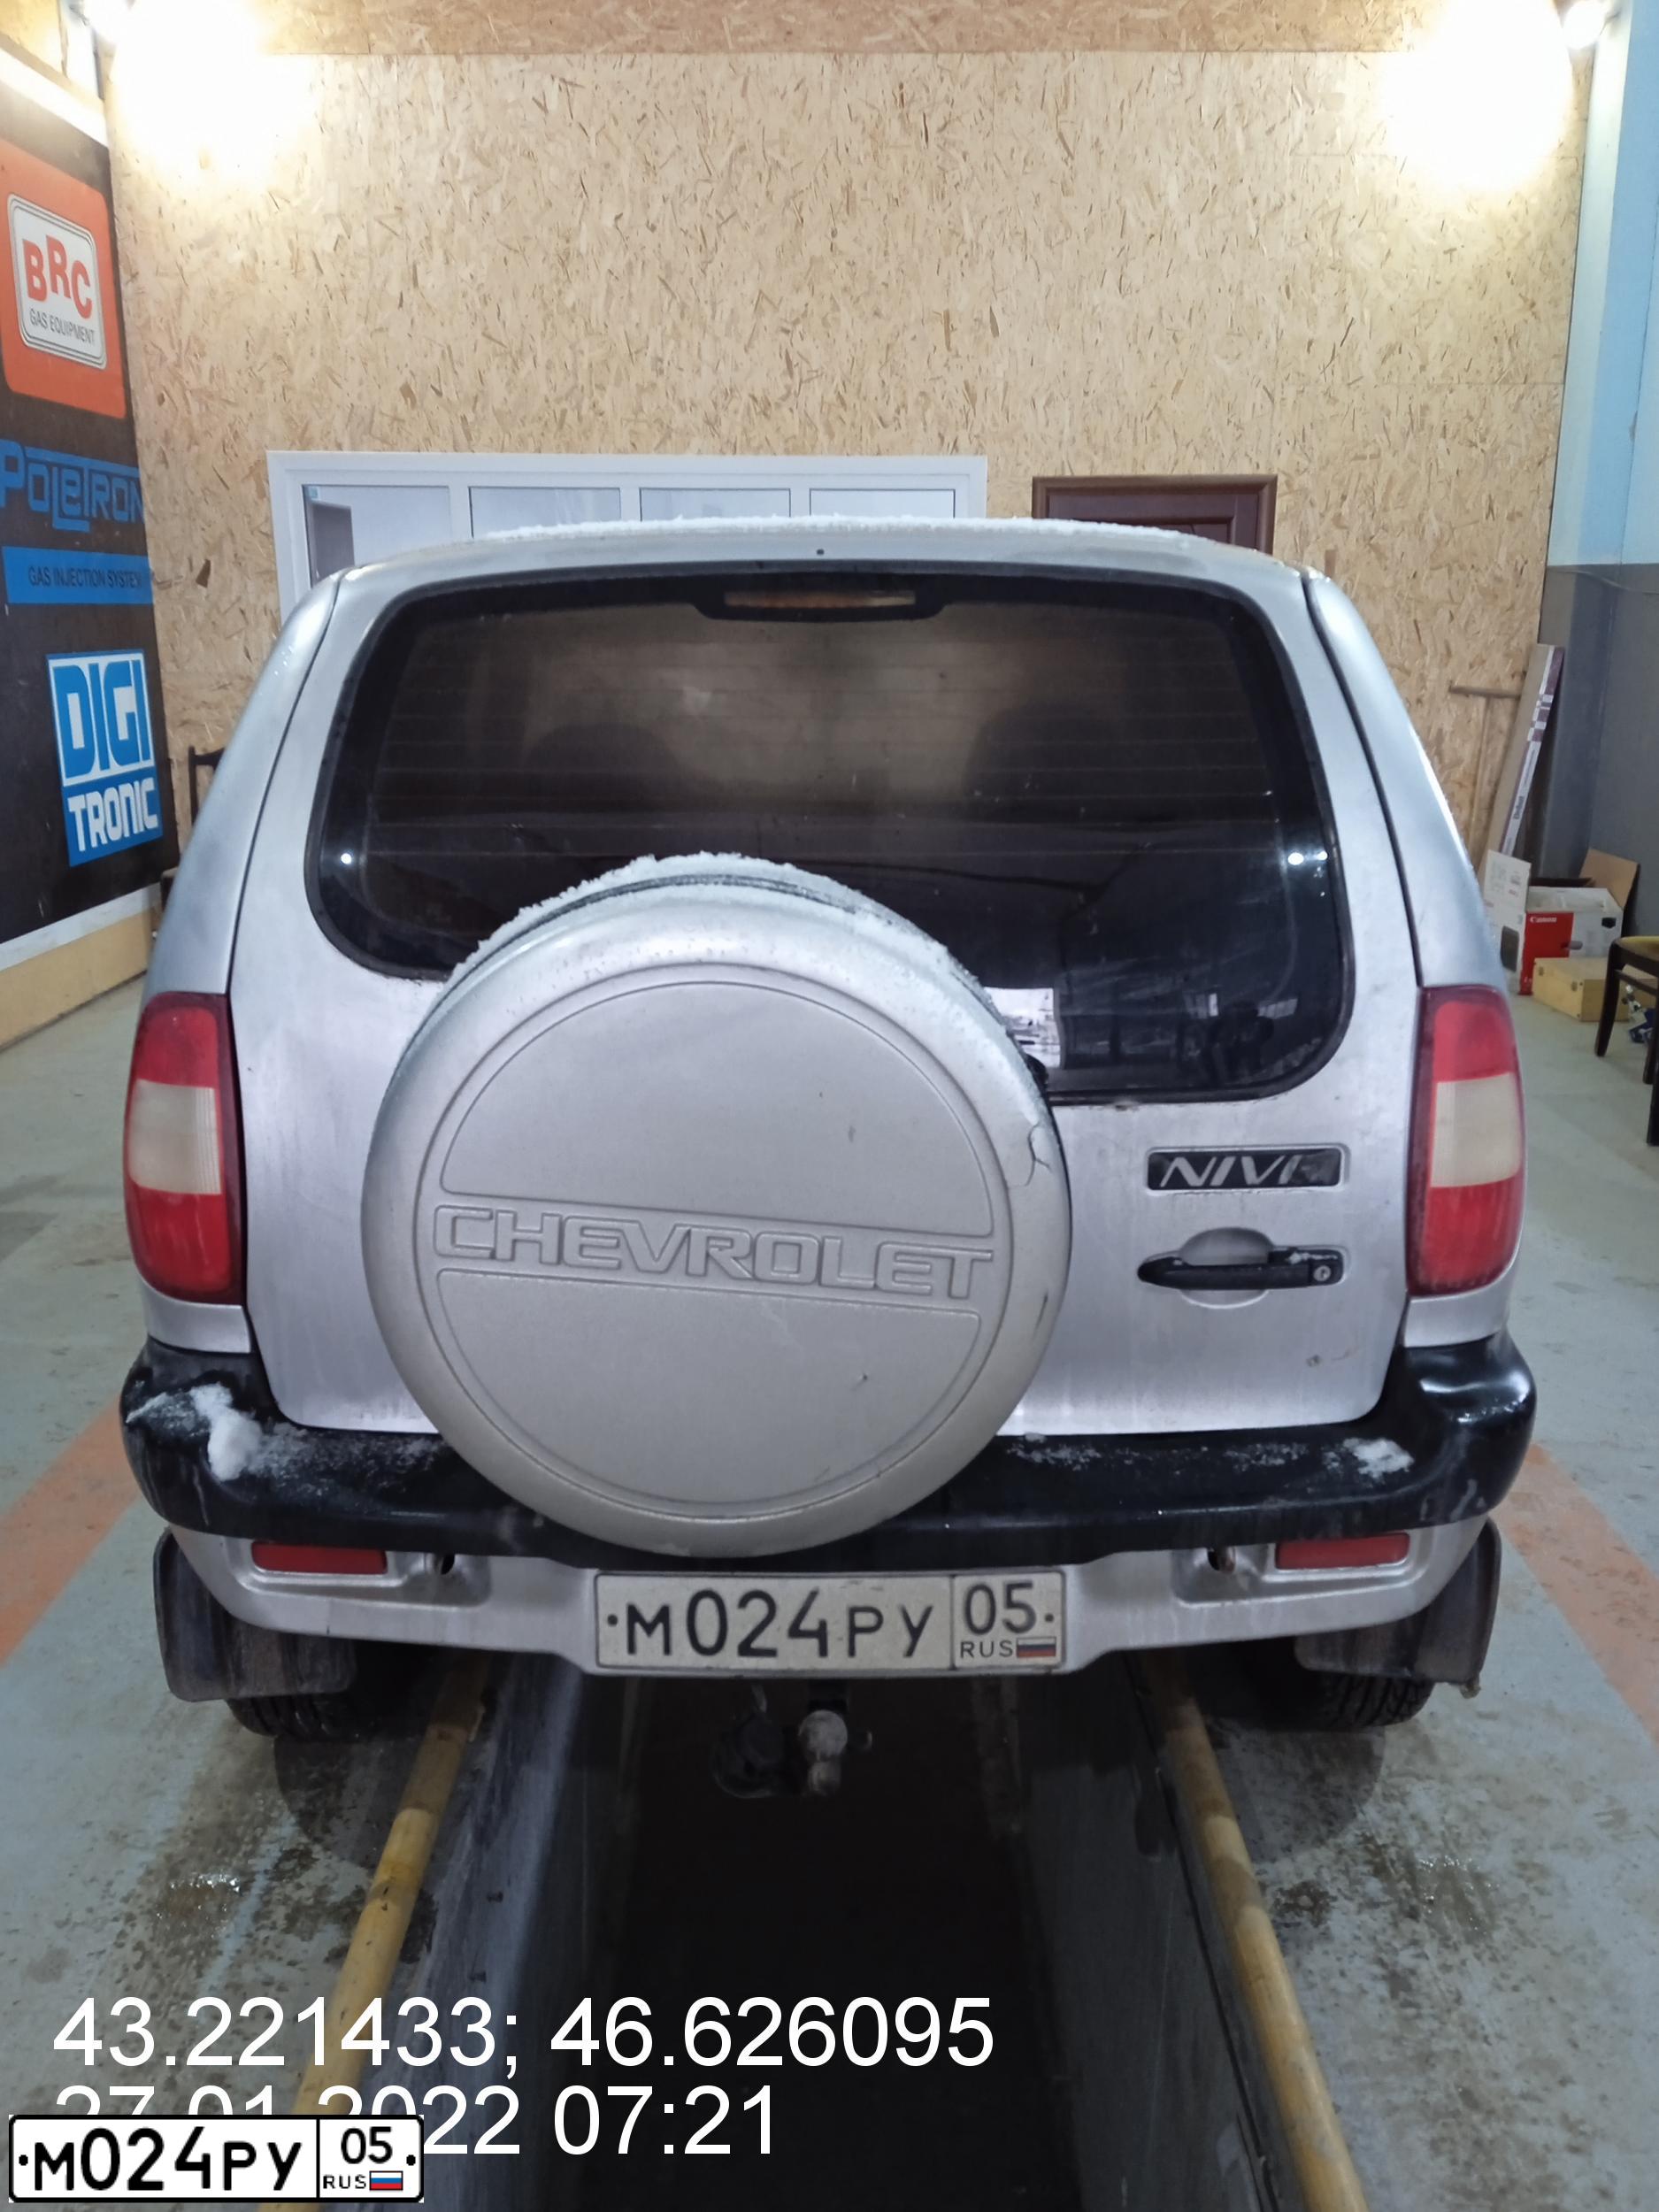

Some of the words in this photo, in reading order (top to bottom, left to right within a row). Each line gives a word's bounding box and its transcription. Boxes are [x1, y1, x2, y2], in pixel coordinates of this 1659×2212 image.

[22, 234, 92, 319] BRC
[29, 308, 47, 326] GAS
[50, 316, 96, 344] EQUIPMENT
[28, 565, 51, 587] GAS
[53, 568, 105, 588] INJECTION
[53, 659, 151, 779] DIGI
[68, 777, 158, 852] TRONIC
[434, 1205, 994, 1300] CHEVROLET
[964, 1581, 1037, 1636] 05
[960, 1640, 1014, 1659] RUS
